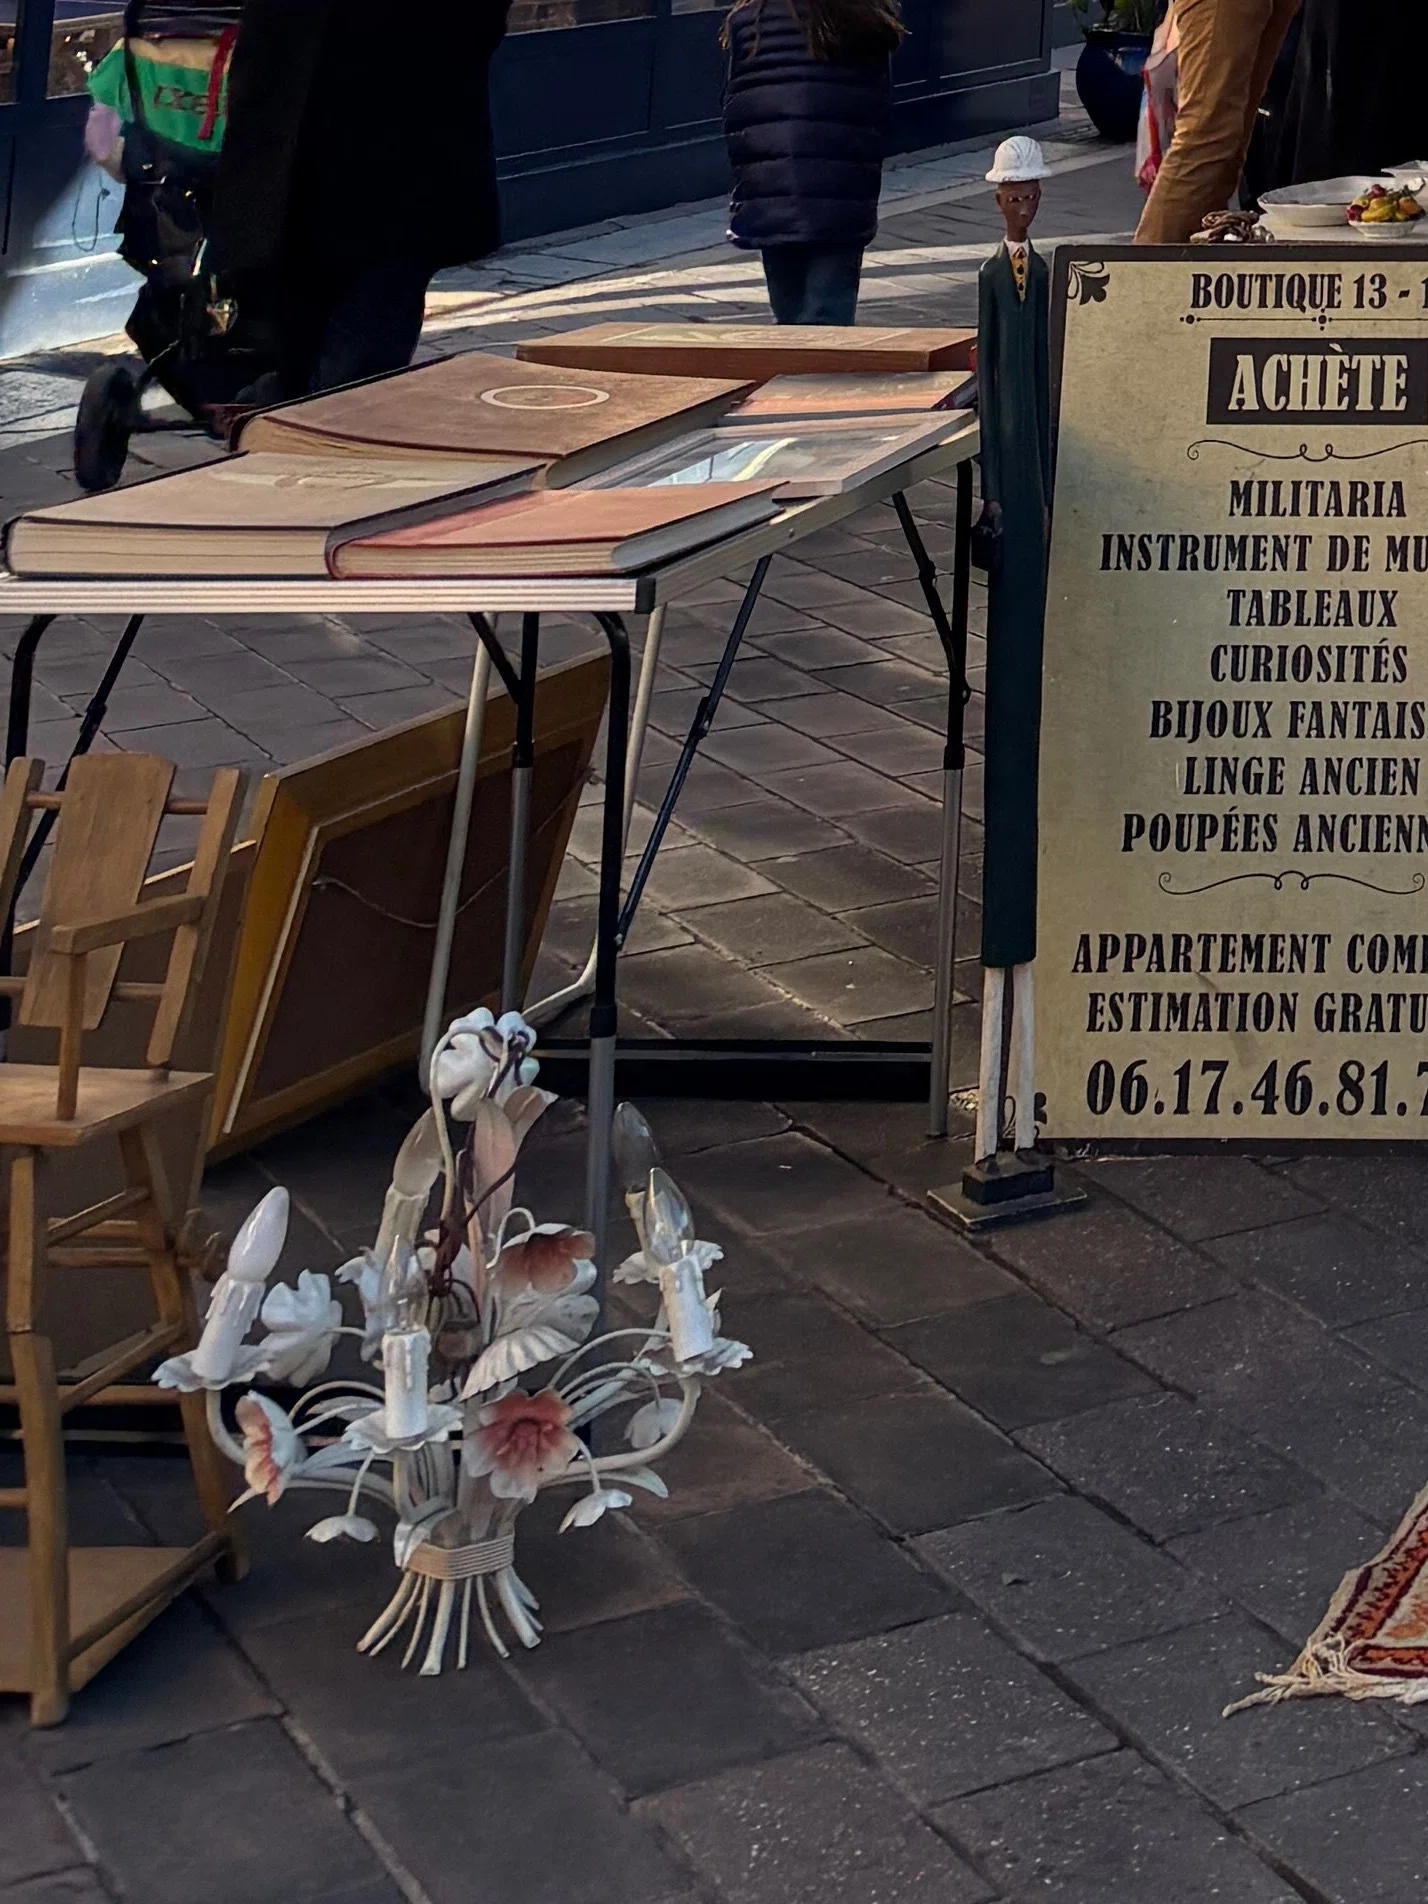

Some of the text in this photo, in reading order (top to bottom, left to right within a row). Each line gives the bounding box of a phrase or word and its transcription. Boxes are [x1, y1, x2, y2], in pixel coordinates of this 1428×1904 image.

[1191, 273, 1342, 313] BOUTIQUE
[1354, 274, 1387, 309] 13
[1228, 343, 1407, 410] ACHÈTE
[1229, 480, 1406, 517] MILITARIA
[1100, 534, 1312, 571] INSTRUMENT
[1327, 535, 1370, 571] DE
[1227, 590, 1398, 627] TABLEAUX
[1211, 638, 1407, 683] CURIOSITÉS
[1150, 700, 1272, 744] BIJOUX
[1184, 757, 1420, 795] LINGE ANCIEN
[1122, 806, 1277, 852] POUPÉES
[1072, 934, 1331, 973] APPARTEMENT
[1086, 992, 1298, 1032] ESTIMATION
